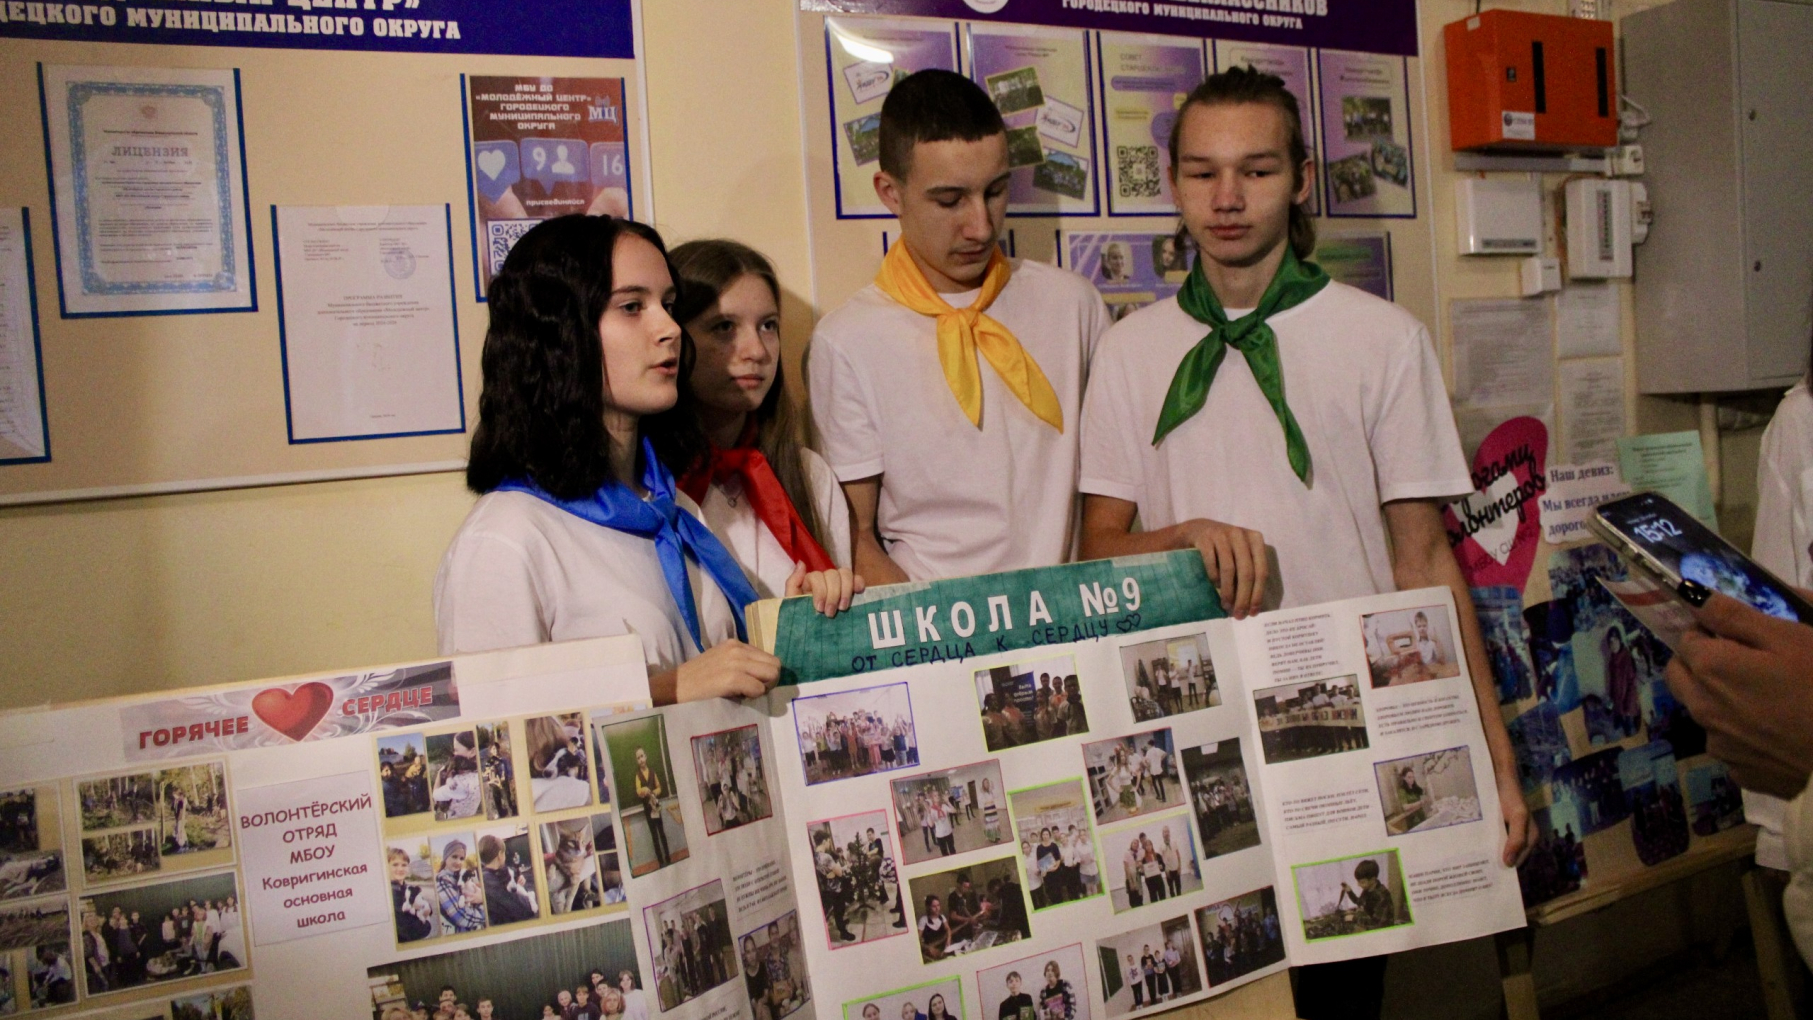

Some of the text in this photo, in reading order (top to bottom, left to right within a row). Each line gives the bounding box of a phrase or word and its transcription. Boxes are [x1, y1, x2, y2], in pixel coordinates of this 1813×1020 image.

[126, 7, 364, 36] МУНИЦИПАЛЬНОГО
[373, 17, 461, 39] ОКРУГА
[1153, 3, 1260, 25] МУНИЦИПАЛЬНОГО
[1262, 14, 1303, 30] ОКРУГА
[514, 84, 553, 92] МБУ ДО
[490, 112, 581, 121] МУНИЦИПАЛЬНОГО
[500, 103, 570, 112] ГОРОДЕЦКОГО
[518, 122, 556, 130] ОКРУГА
[111, 146, 189, 158] ЛИЦЕНЗИЯ
[532, 146, 546, 172] 9
[602, 154, 624, 176] 16
[1471, 443, 1535, 491] огами
[1550, 465, 1614, 482] Наш девиз:
[1445, 460, 1547, 548] олонтеров
[1543, 500, 1562, 512] Мы
[1548, 521, 1586, 537] дорого
[1634, 518, 1683, 543] 15:12
[868, 577, 1141, 649] ШКОЛА №9
[891, 641, 977, 668] СЕРДЦА
[996, 635, 1010, 652] К
[1031, 619, 1109, 645] СЕРДЦУ
[139, 686, 433, 749] ГОРЯЧЕЕ СЕРДЦЕ
[240, 793, 372, 829] ВОЛОНТЁРСКИЙ
[282, 823, 338, 844] ОТРЯД
[290, 845, 335, 864] МБОУ
[262, 864, 368, 890] Ковригинская
[283, 888, 353, 908] основная
[296, 911, 346, 928] школа
